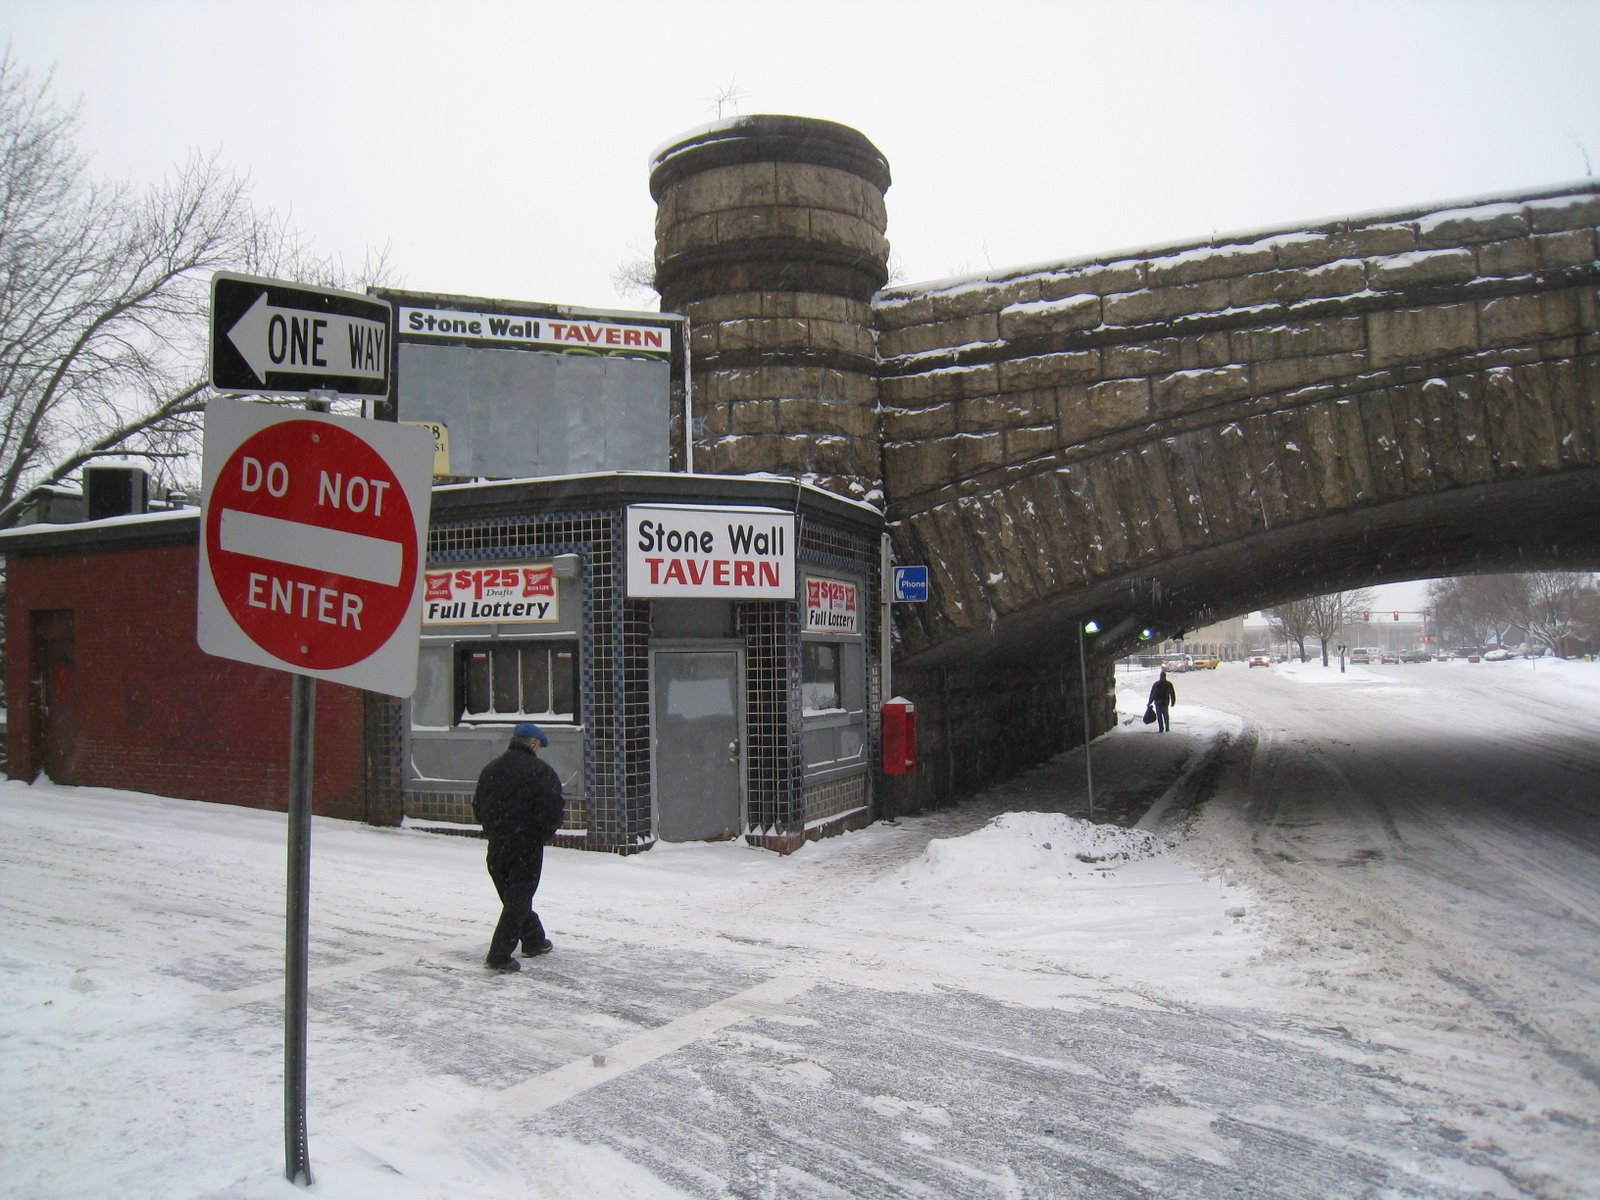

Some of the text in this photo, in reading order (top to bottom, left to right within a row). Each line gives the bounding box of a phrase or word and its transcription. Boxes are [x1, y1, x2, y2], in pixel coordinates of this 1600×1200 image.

[267, 313, 384, 373] ONE WAY
[408, 311, 663, 348] Stone Wall TAVERN
[241, 456, 390, 517] DO NOT
[638, 519, 784, 556] Stone Wall
[455, 568, 520, 600] $125
[645, 558, 780, 587] TAVERN
[901, 580, 926, 588] Phone
[247, 571, 364, 631] ENTER
[486, 587, 514, 598] Drafts
[428, 601, 550, 619] Full Lottery
[810, 609, 855, 630] Full Lottery
